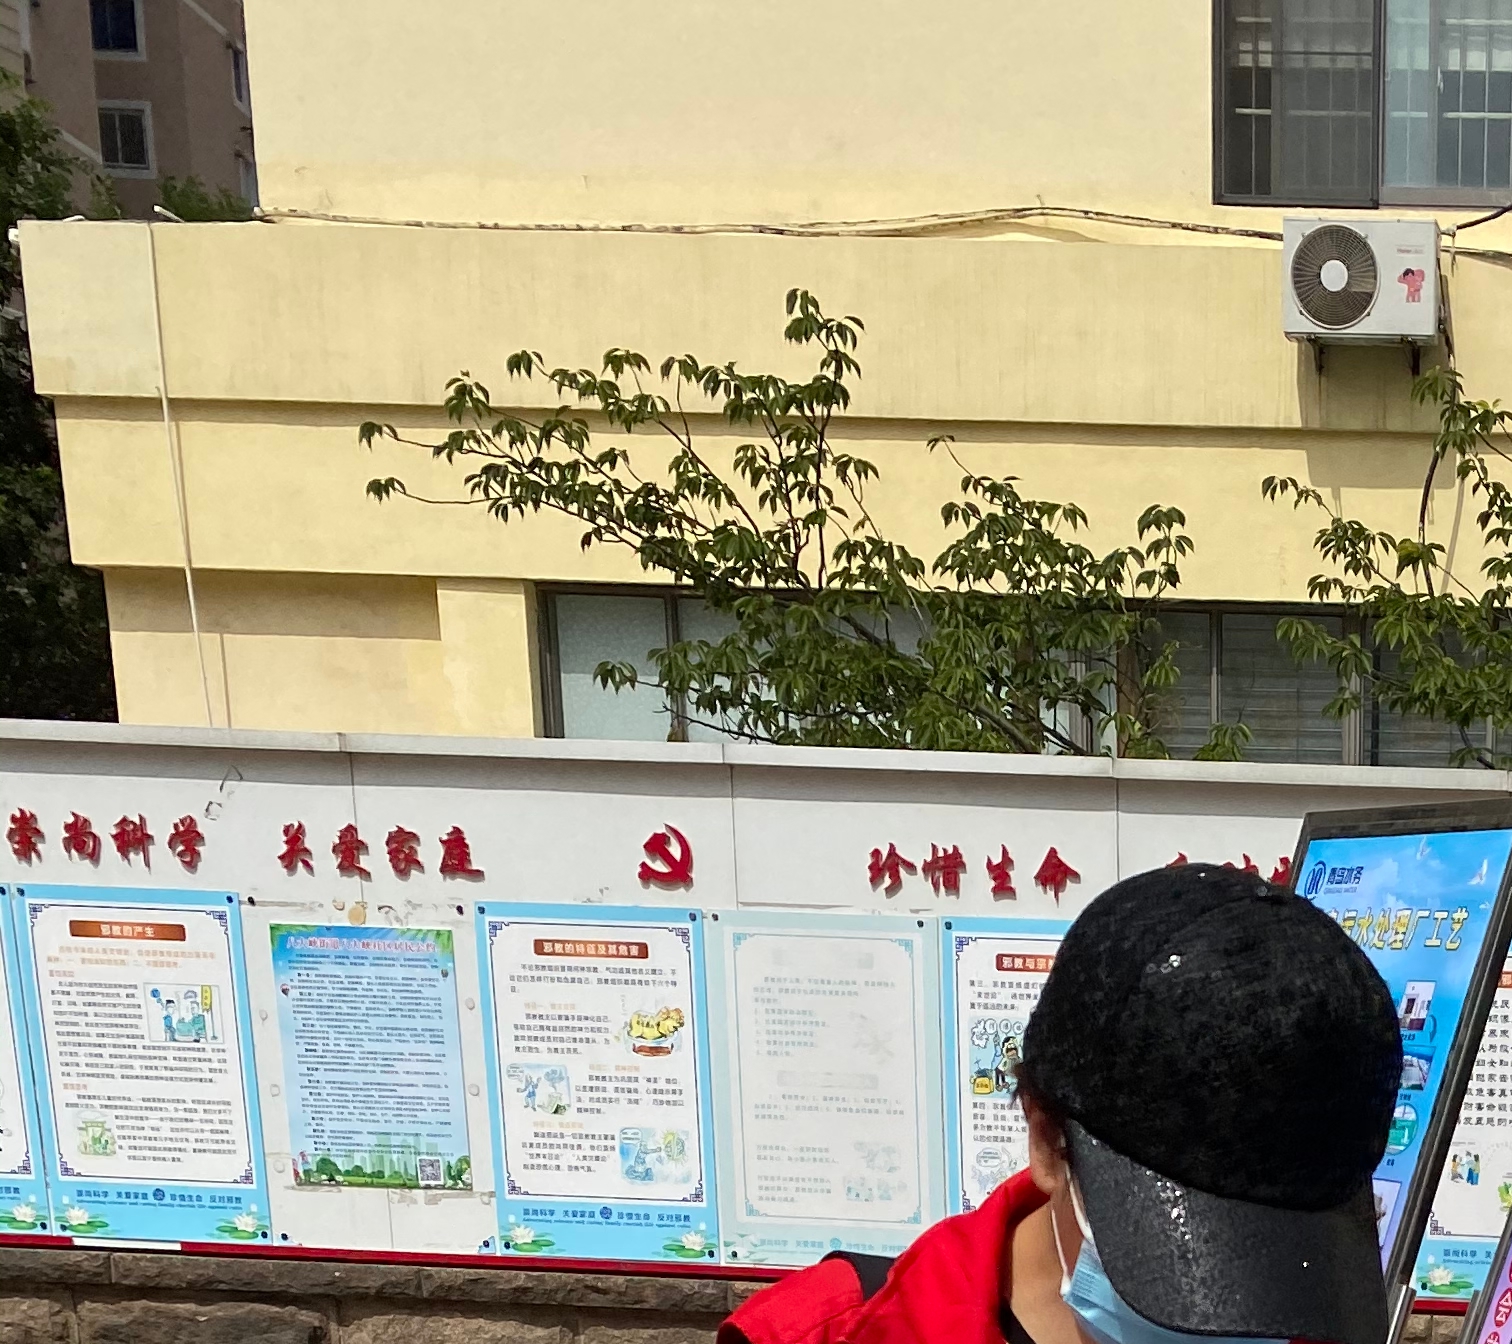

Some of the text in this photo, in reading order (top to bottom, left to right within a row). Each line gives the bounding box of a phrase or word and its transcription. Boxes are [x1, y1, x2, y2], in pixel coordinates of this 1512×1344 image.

[6, 806, 485, 882] 崇尚科学 关爱家庭
[867, 841, 1081, 905] 珍惜生命
[100, 924, 155, 937] 邪教的产生
[543, 941, 640, 956] 邪教的特征及其危害
